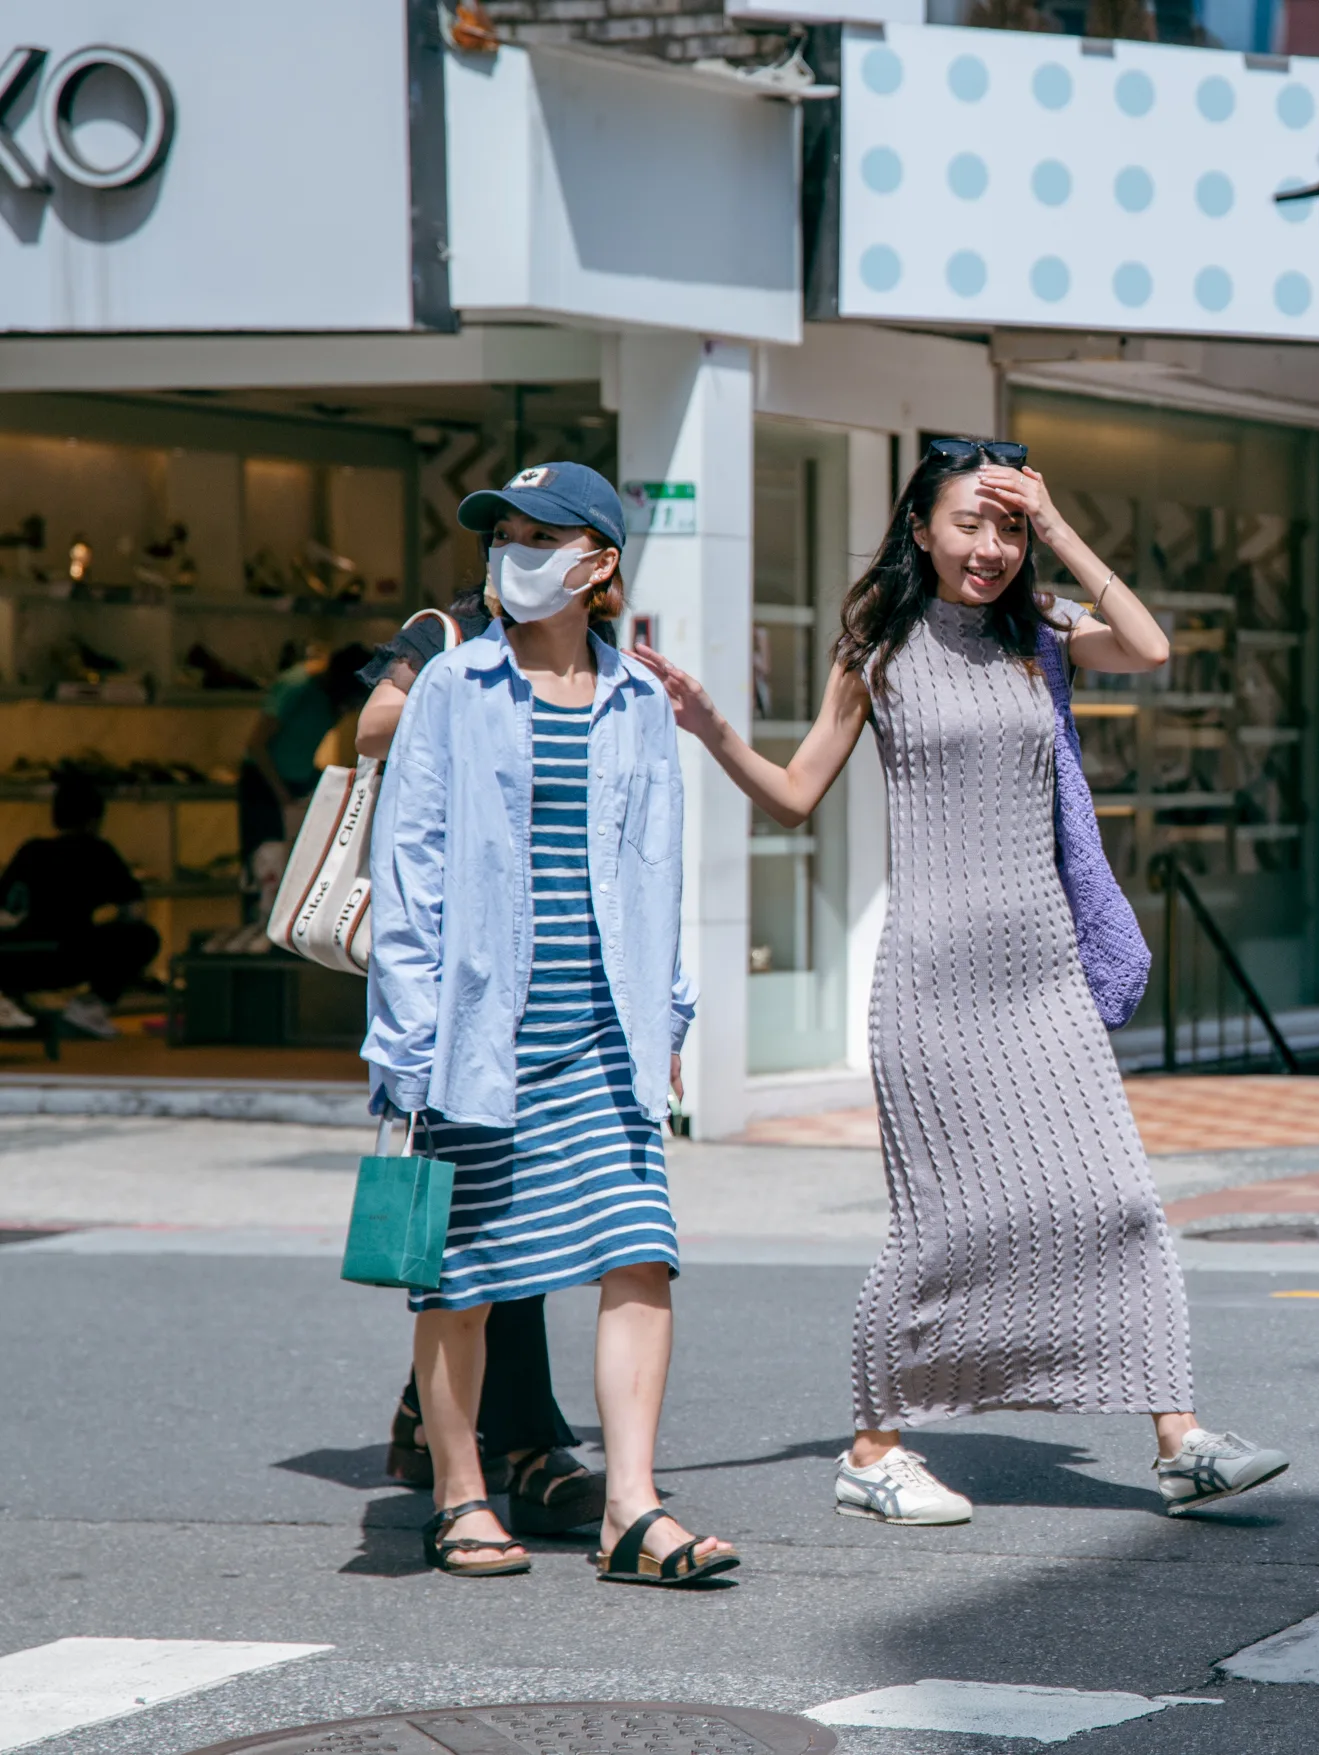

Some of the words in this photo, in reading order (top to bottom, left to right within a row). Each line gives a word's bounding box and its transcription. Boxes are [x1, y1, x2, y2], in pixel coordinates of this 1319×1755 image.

[338, 788, 367, 847] Chloé
[296, 881, 331, 937] Chloé
[333, 887, 363, 947] Chloé
